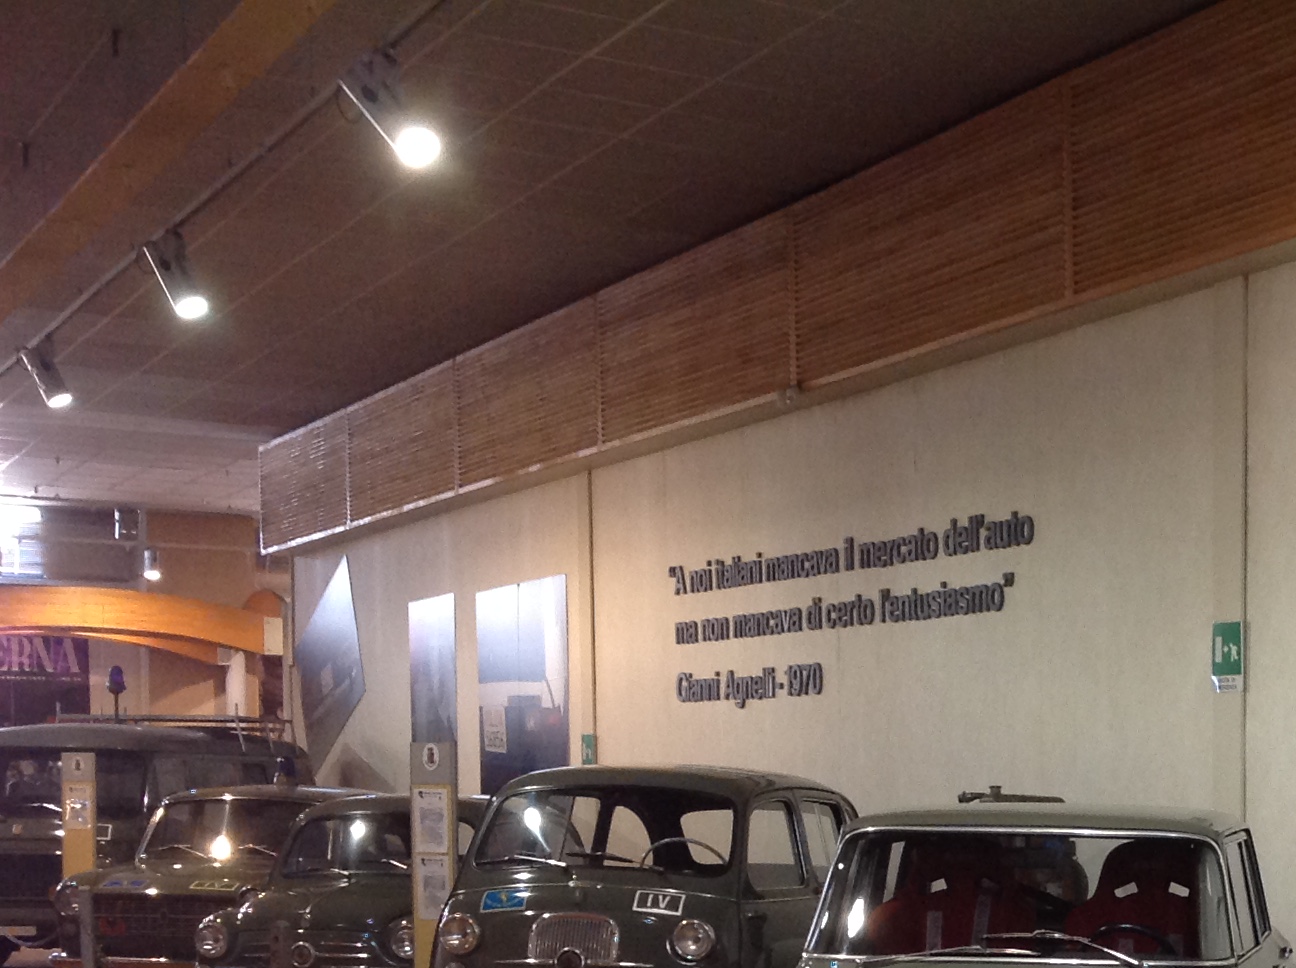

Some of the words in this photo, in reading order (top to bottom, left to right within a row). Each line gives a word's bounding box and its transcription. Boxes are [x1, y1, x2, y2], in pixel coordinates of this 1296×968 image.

[689, 560, 713, 593] noi
[714, 552, 763, 590] italiani
[764, 547, 839, 582] mancava
[843, 536, 855, 571] il
[858, 527, 939, 569] mercato
[943, 511, 1035, 556] dell'auto
[675, 620, 699, 644] ma
[700, 616, 730, 642] non
[732, 607, 802, 638] mancava
[806, 596, 823, 630] di
[825, 594, 876, 629] certo
[675, 671, 721, 702] Gianni
[724, 667, 776, 709] Agnelli
[785, 662, 823, 697] 1970
[647, 893, 671, 909] IV
